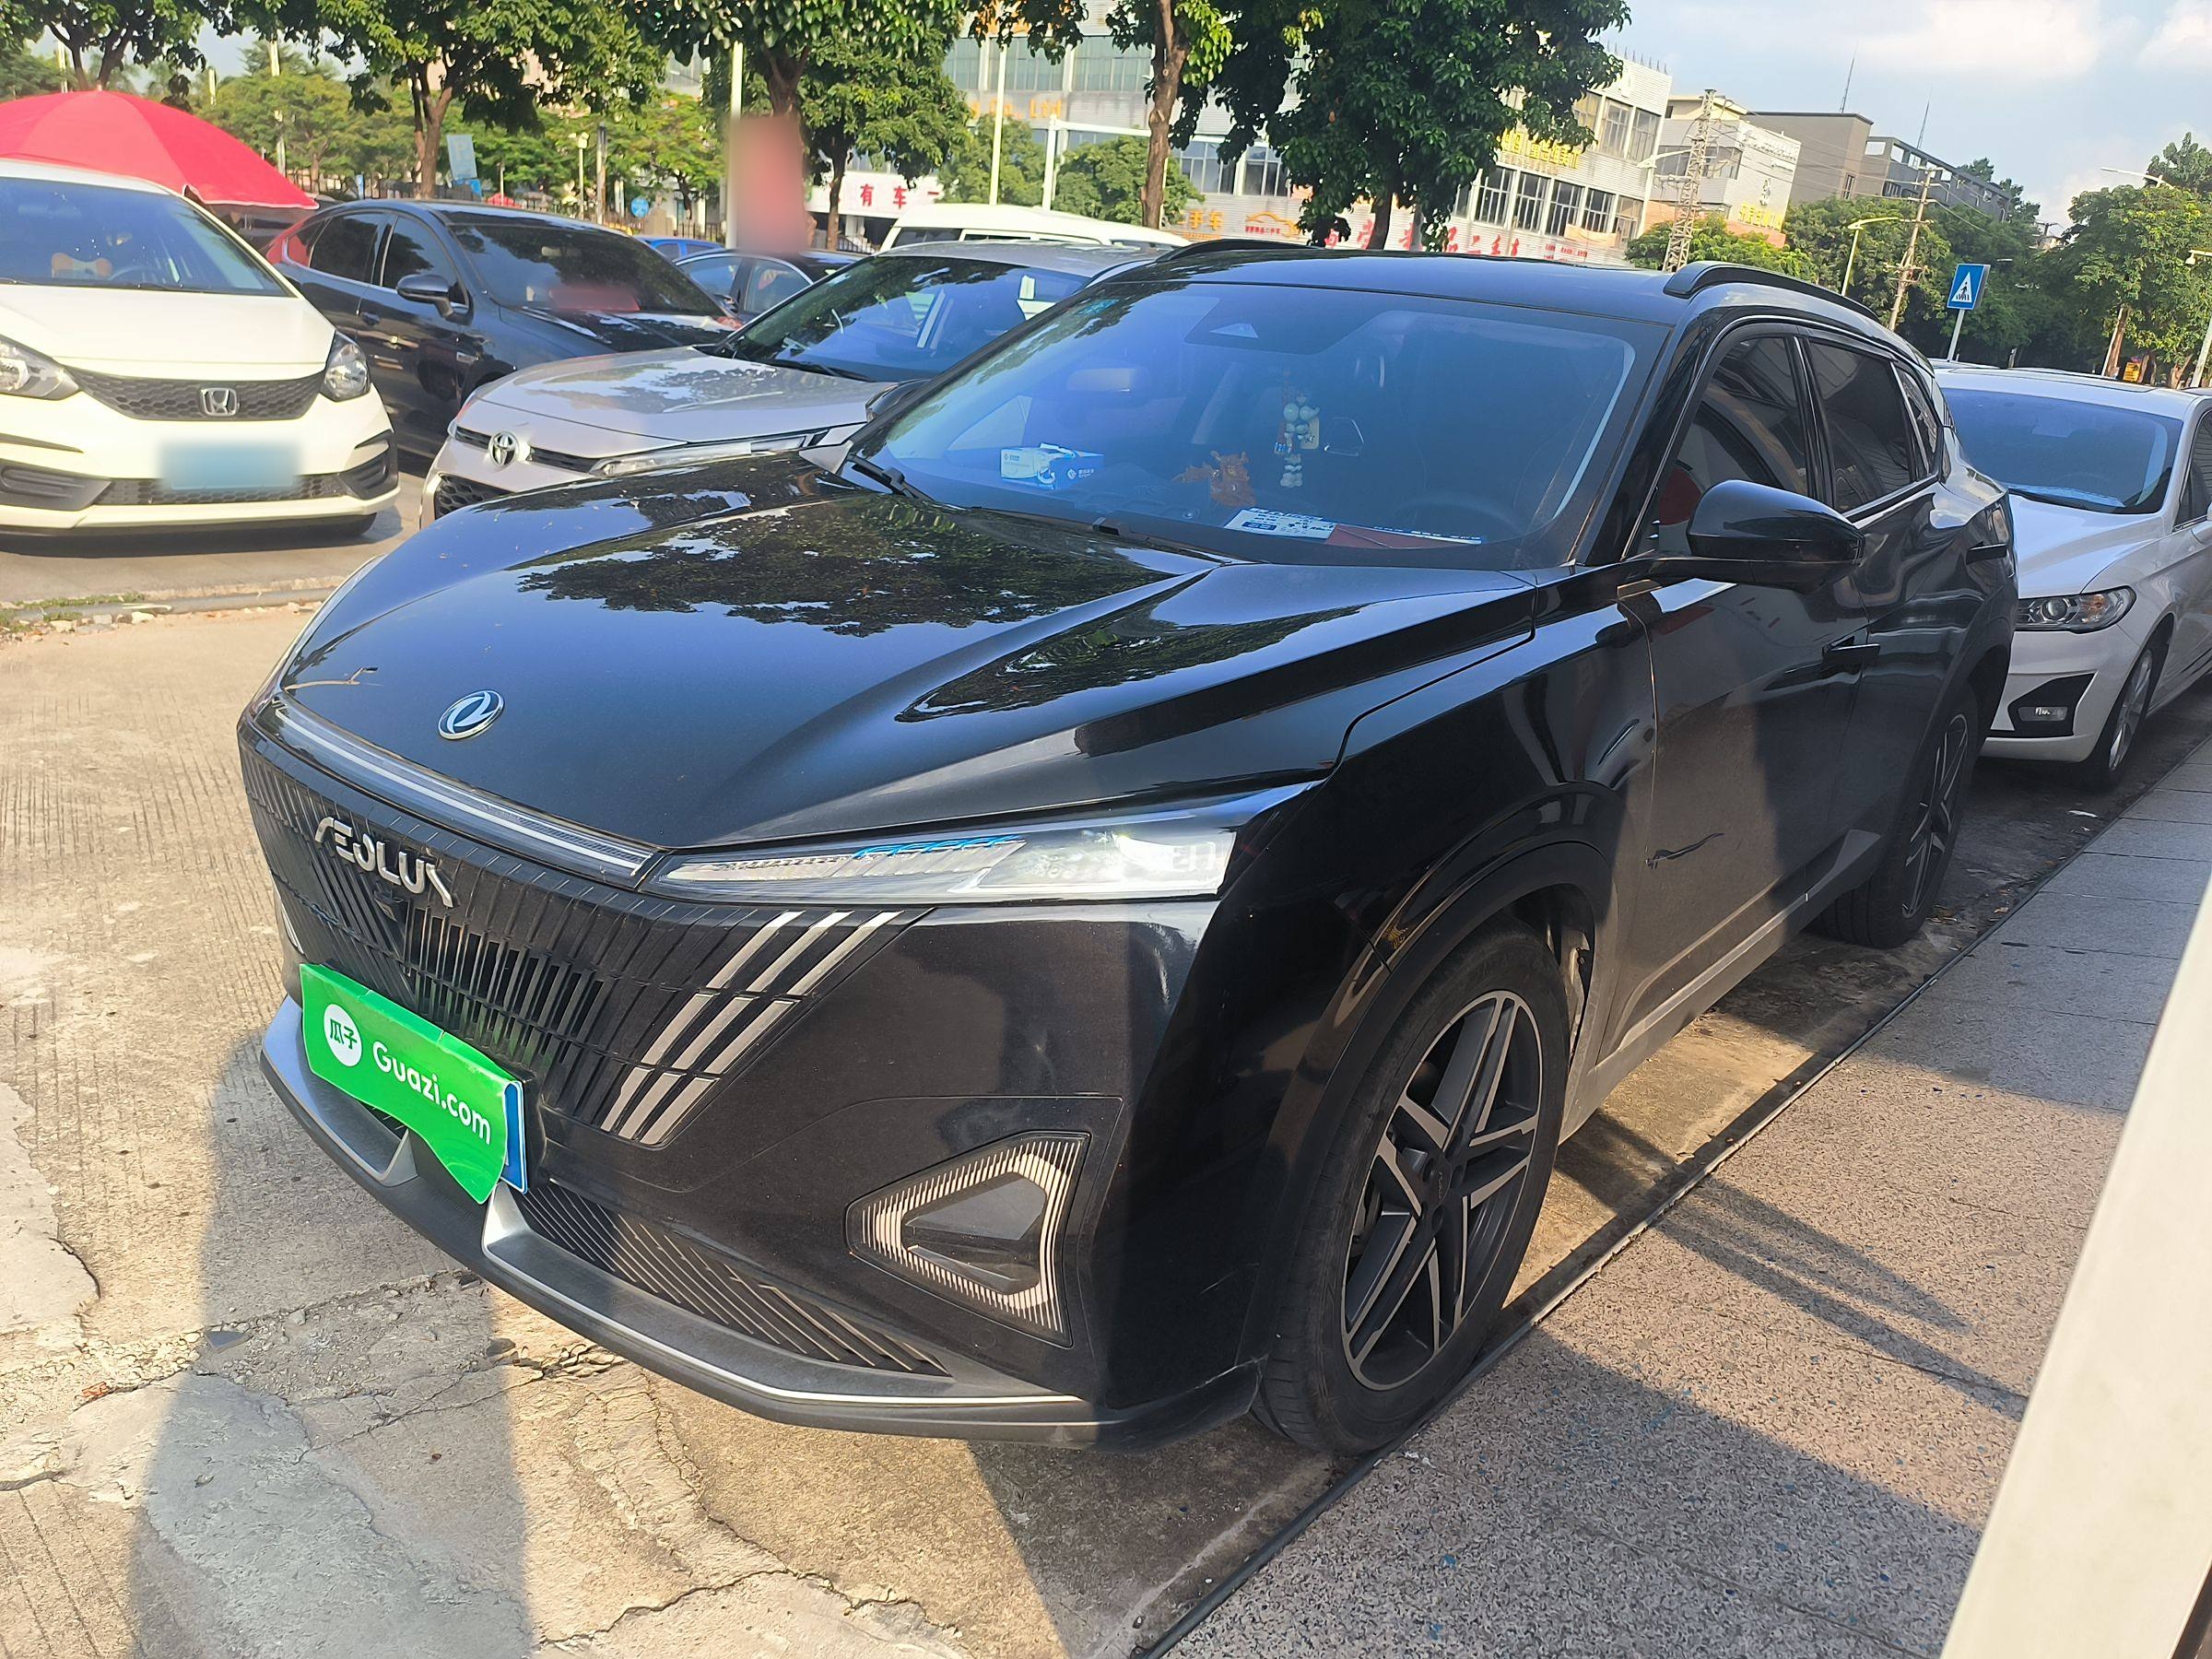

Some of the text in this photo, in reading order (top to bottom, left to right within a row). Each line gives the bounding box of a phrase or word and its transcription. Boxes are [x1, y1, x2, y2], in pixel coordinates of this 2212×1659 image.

[314, 816, 453, 908] AEOLUS
[329, 1018, 358, 1050] 瓜子
[372, 1041, 491, 1146] Guazi.com
